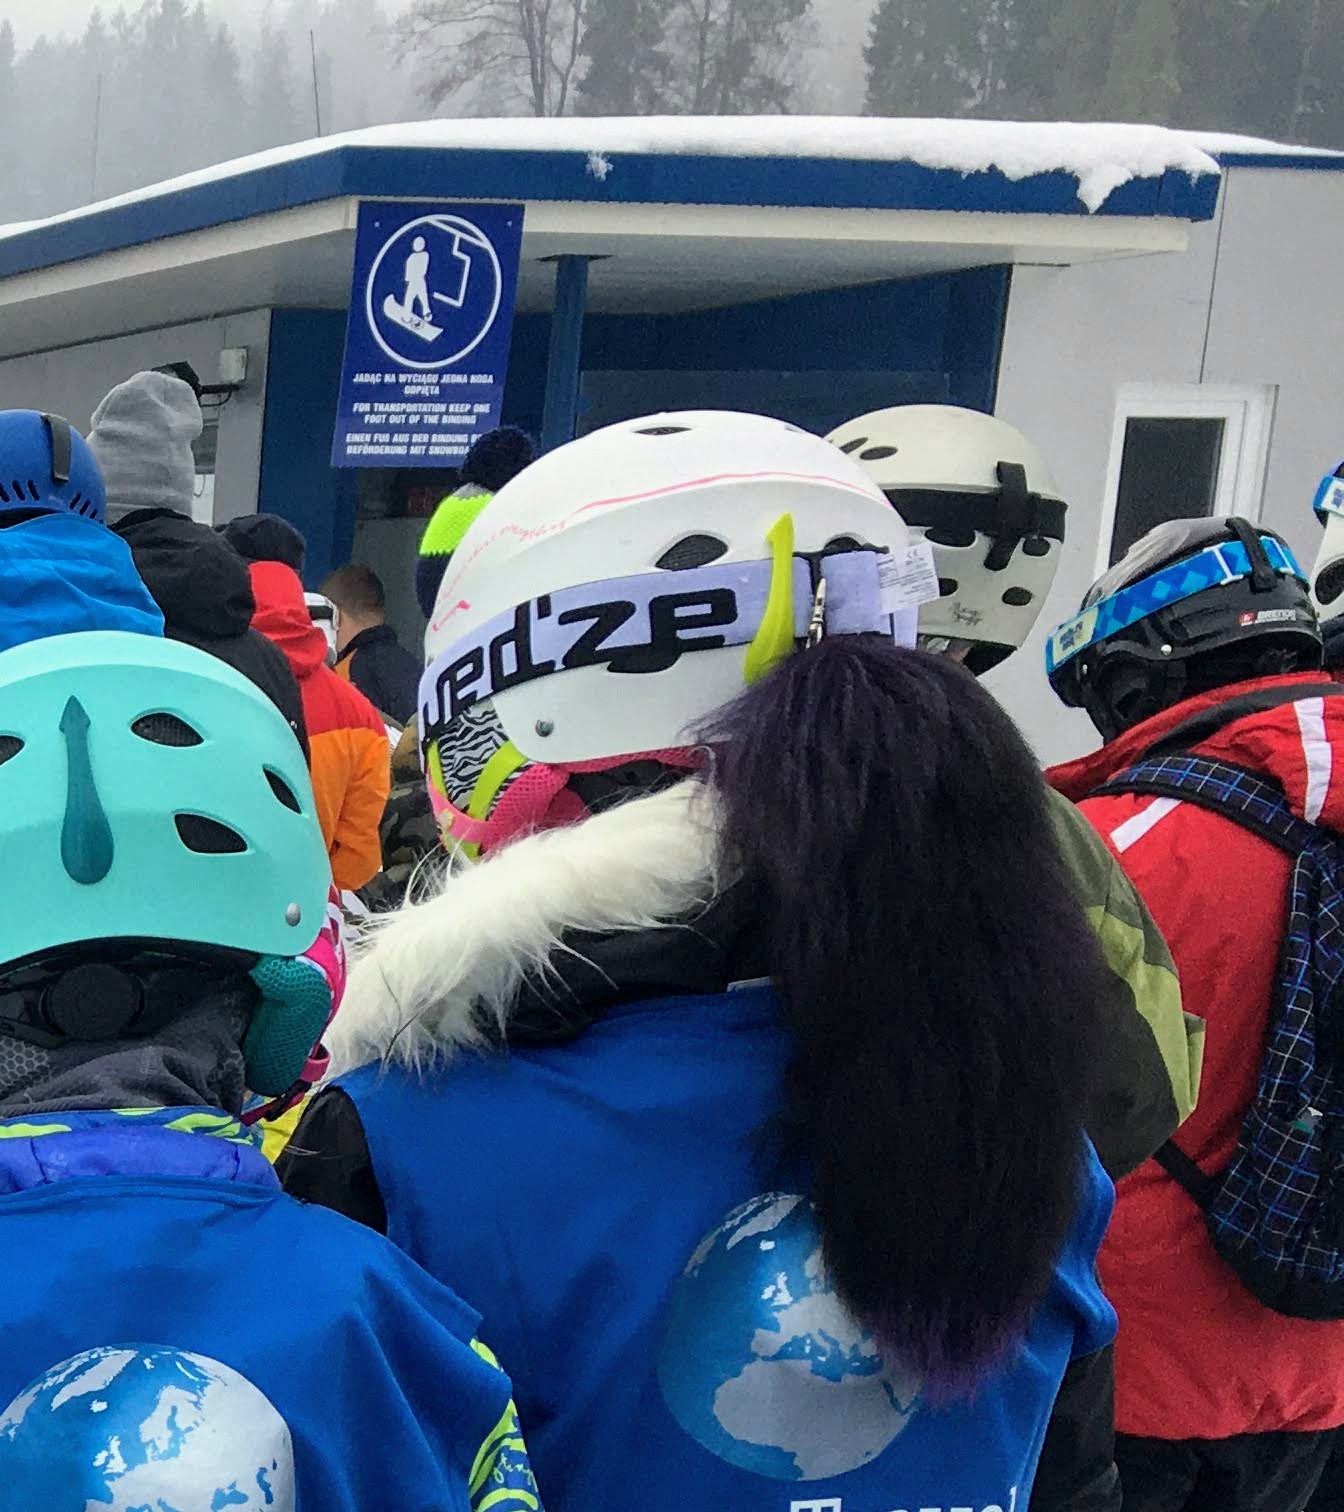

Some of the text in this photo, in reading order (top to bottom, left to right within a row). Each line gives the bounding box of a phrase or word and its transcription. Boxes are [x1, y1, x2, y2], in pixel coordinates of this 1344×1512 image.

[384, 373, 396, 383] NA
[353, 403, 491, 413] FOR TRANSPORTATION KEEP ONE
[365, 415, 476, 424] FOOT OUT OF THE BINDING
[431, 434, 468, 443] BINDUNG
[410, 446, 426, 455] MIT
[429, 446, 470, 455] SNOWBOA
